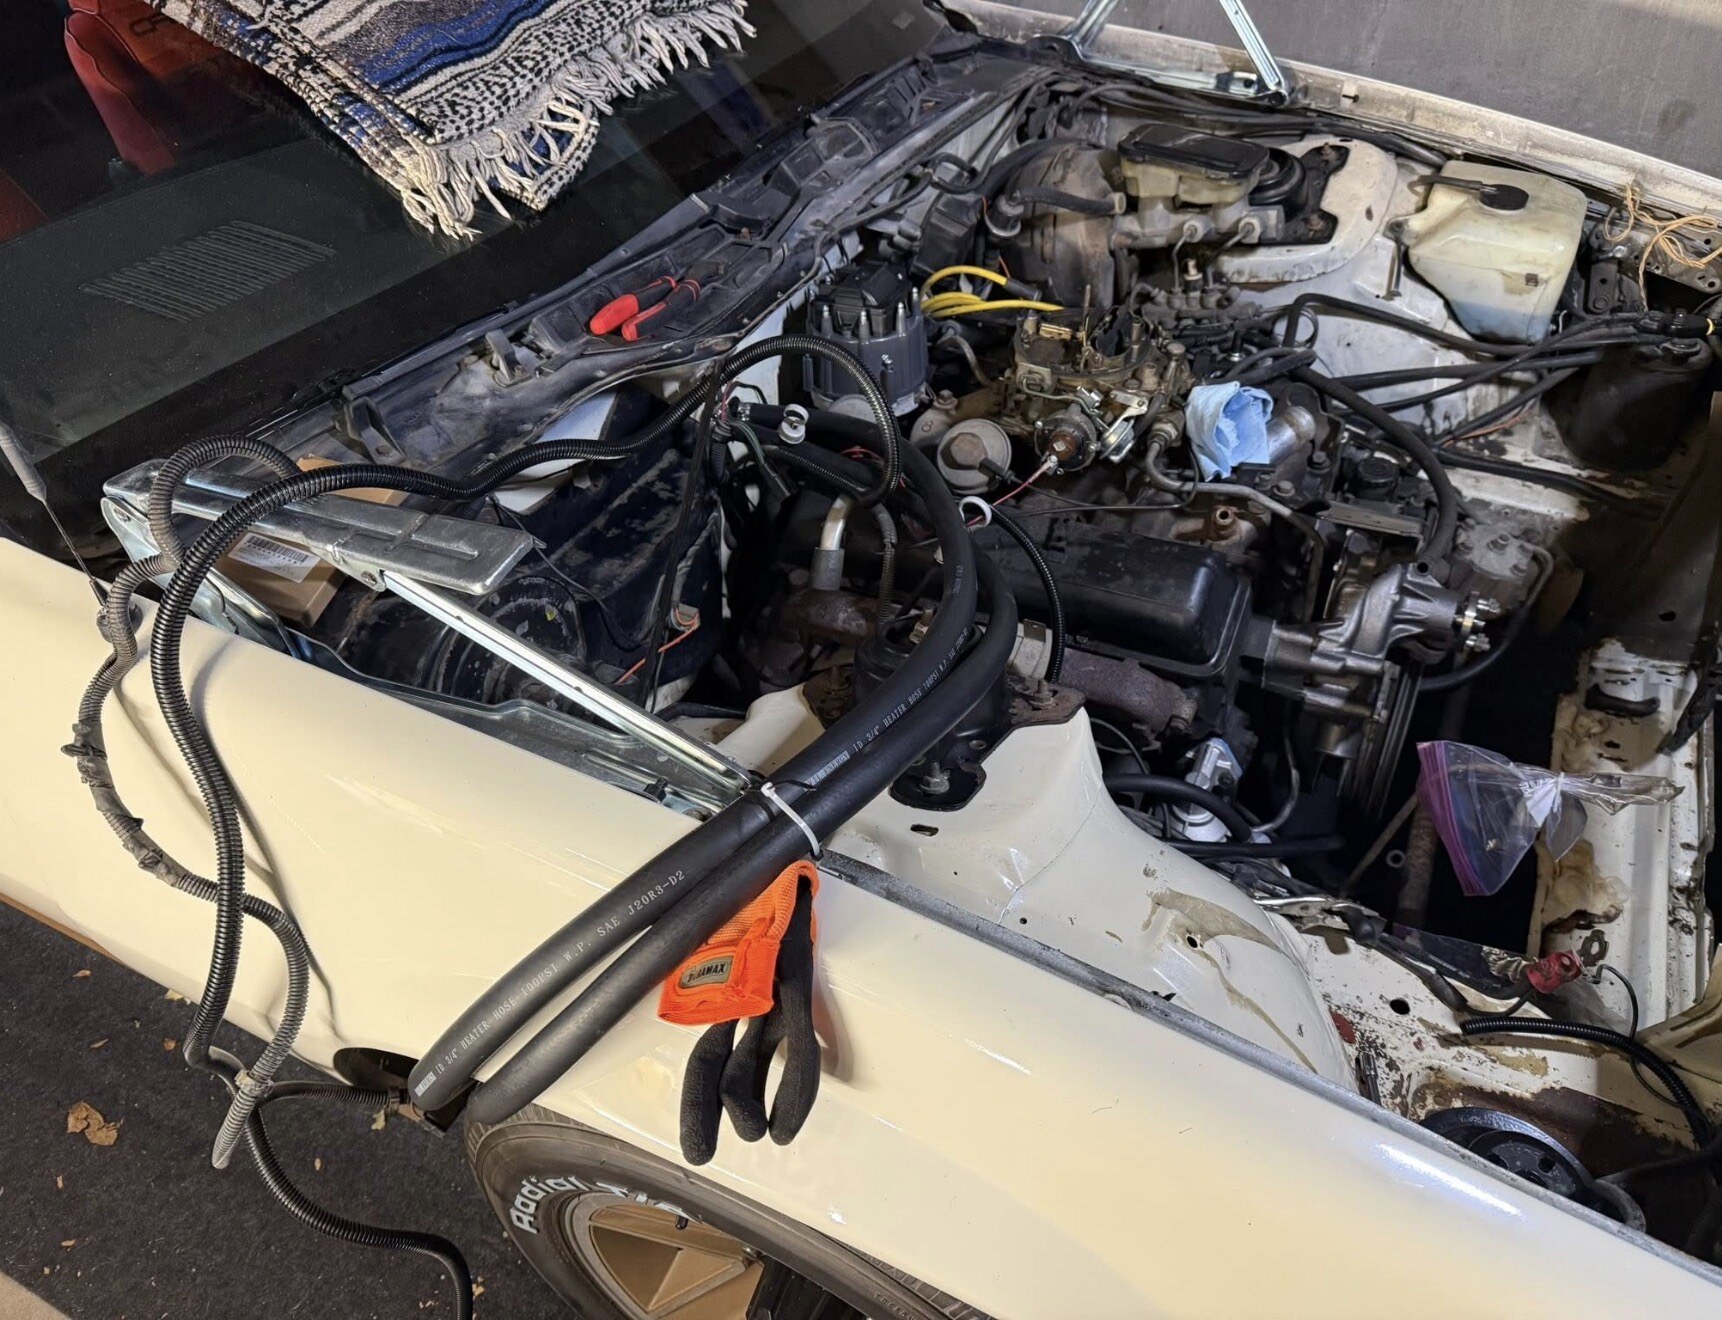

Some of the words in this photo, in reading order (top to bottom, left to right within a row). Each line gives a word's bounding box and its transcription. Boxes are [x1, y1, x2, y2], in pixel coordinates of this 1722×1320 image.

[853, 740, 864, 752] ID
[866, 725, 880, 742] 3/4"
[882, 703, 908, 728] HEATER
[435, 1065, 446, 1075] ID
[445, 1047, 459, 1064] 3/4"
[460, 1020, 491, 1050] HEATER
[492, 998, 517, 1020] HOSE
[521, 963, 559, 997] 100PSI
[563, 941, 592, 962] W.P.
[597, 916, 621, 937] SAE
[628, 870, 685, 915] J20R3-D2
[509, 1175, 592, 1235] Radial
